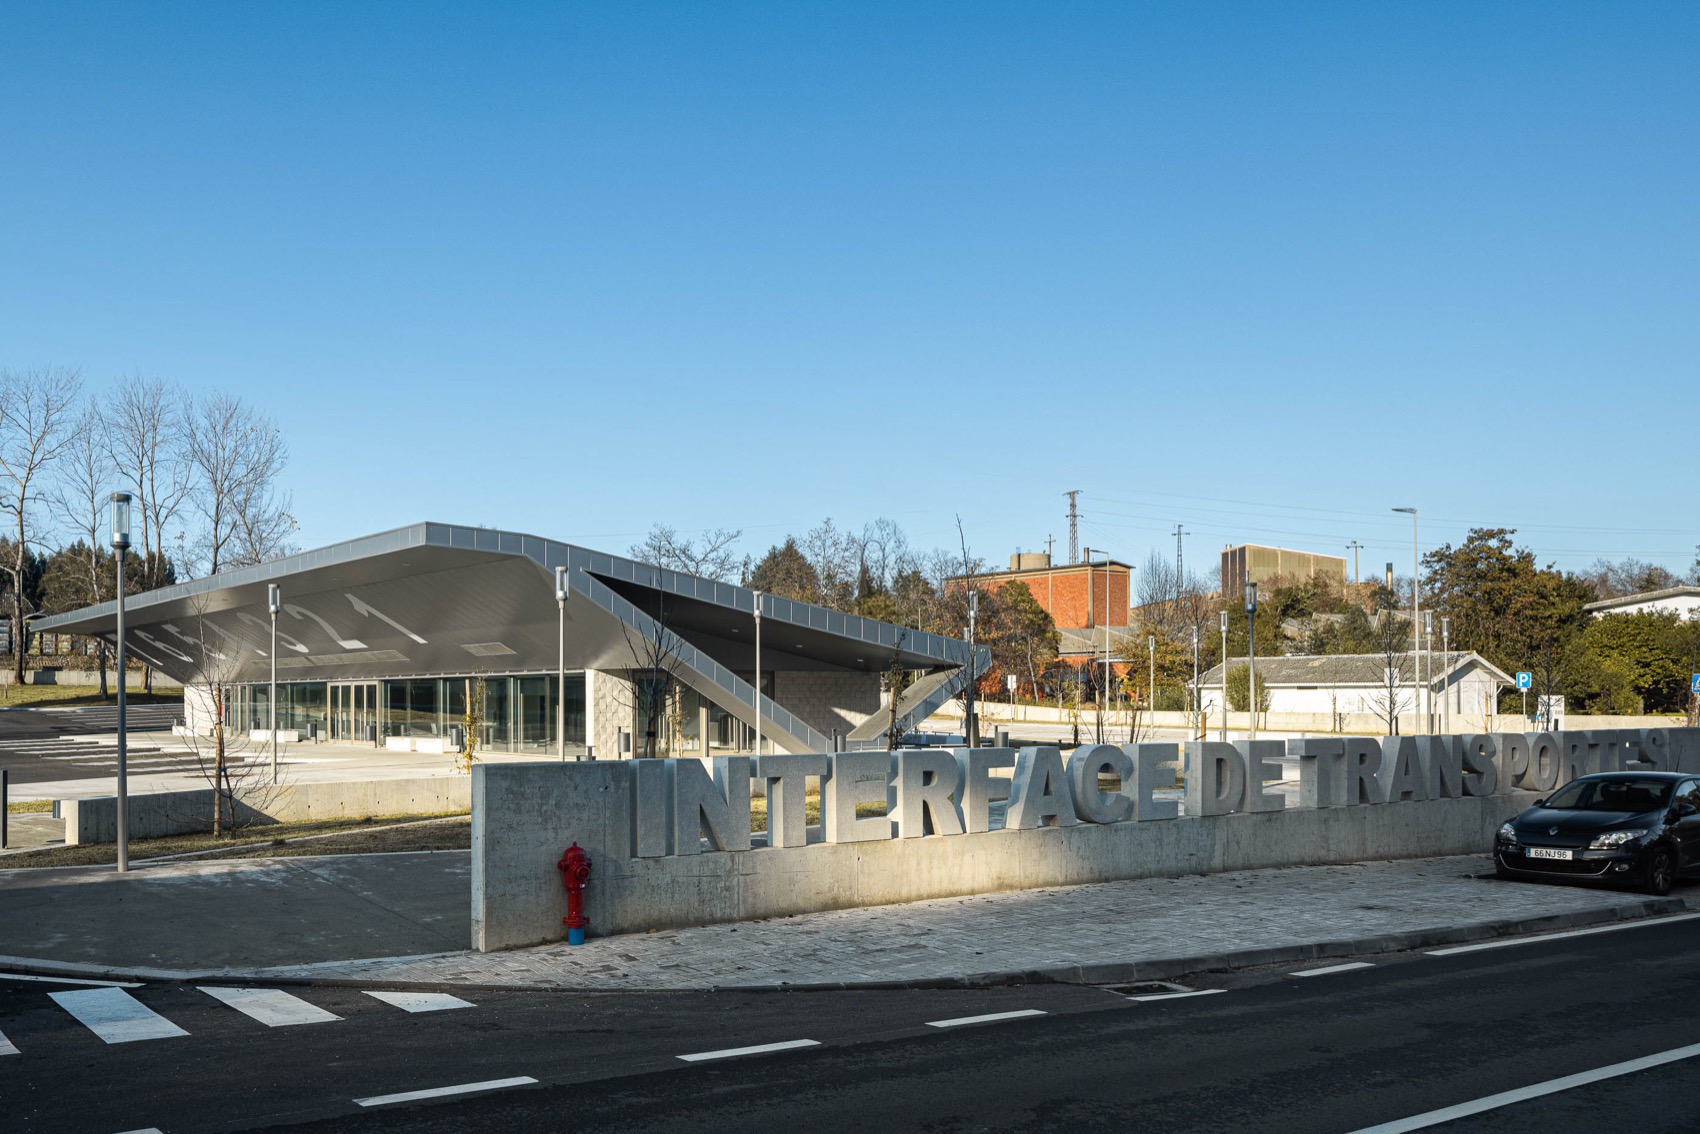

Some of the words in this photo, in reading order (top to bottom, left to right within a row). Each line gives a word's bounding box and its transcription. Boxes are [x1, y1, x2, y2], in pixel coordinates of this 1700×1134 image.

[237, 612, 310, 653] 3
[283, 603, 369, 650] 2
[344, 593, 429, 644] 1
[134, 629, 194, 663] 6
[161, 624, 226, 660] 5
[1519, 673, 1529, 687] P
[637, 742, 1179, 858] INTERFACE
[1185, 740, 1286, 817] DE
[1288, 728, 1668, 808] TRANSPORTES
